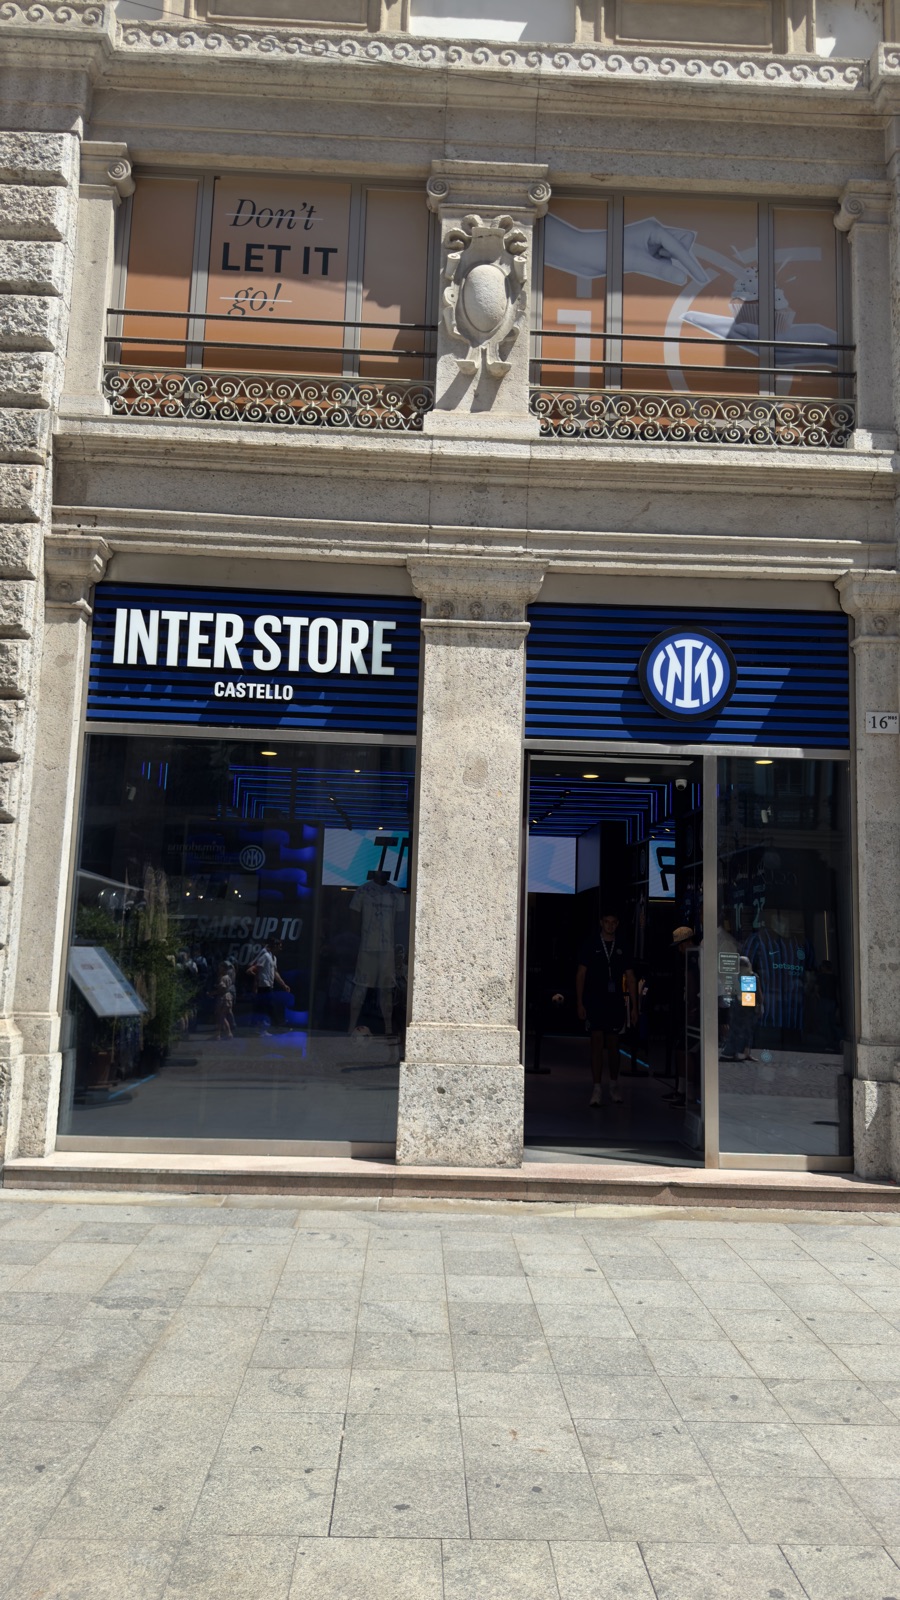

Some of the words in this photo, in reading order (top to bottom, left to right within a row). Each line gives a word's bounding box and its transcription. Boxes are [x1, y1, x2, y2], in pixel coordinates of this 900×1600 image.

[230, 198, 317, 230] Don't
[222, 241, 292, 274] LET
[302, 245, 339, 277] IT
[227, 283, 283, 316] go!
[112, 608, 244, 670] INTER
[252, 614, 397, 676] STORE
[213, 681, 294, 701] CASTELLO
[871, 715, 888, 730] 16
[193, 915, 252, 939] SALES
[252, 916, 279, 940] UP
[280, 917, 304, 941] TO
